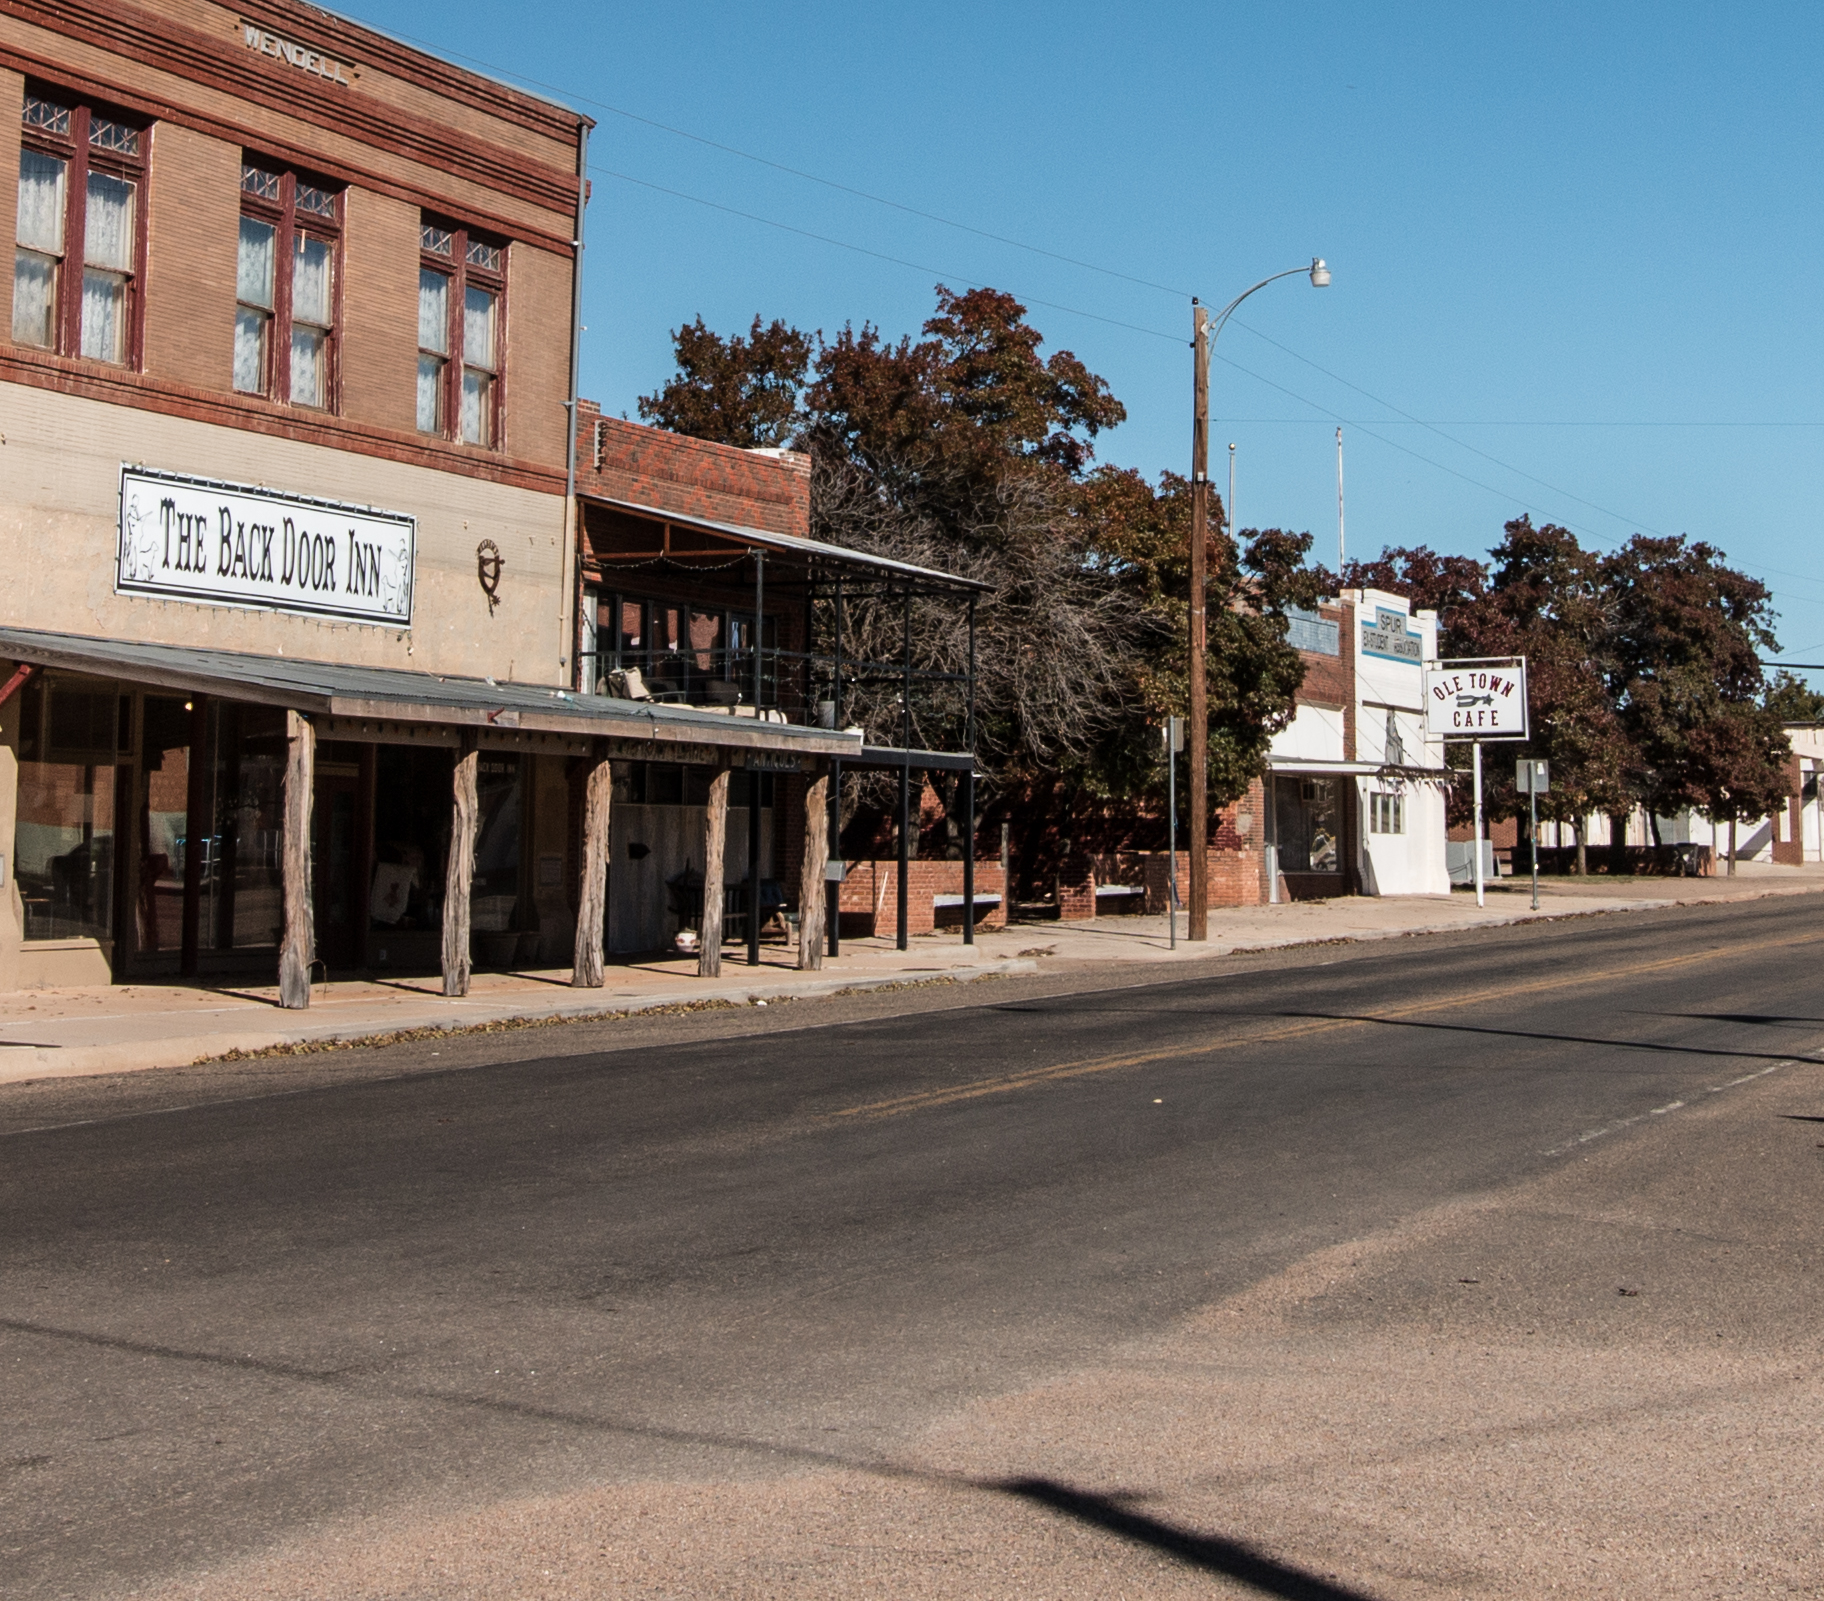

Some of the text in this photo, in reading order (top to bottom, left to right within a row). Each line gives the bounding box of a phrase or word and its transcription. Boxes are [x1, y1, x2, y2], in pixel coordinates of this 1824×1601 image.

[243, 23, 349, 86] WENDELL
[160, 496, 383, 599] THE BACK DOOR INN
[1380, 614, 1403, 635] SPUR
[1433, 672, 1515, 702] OLE TOWN
[1452, 710, 1499, 728] CAFE
